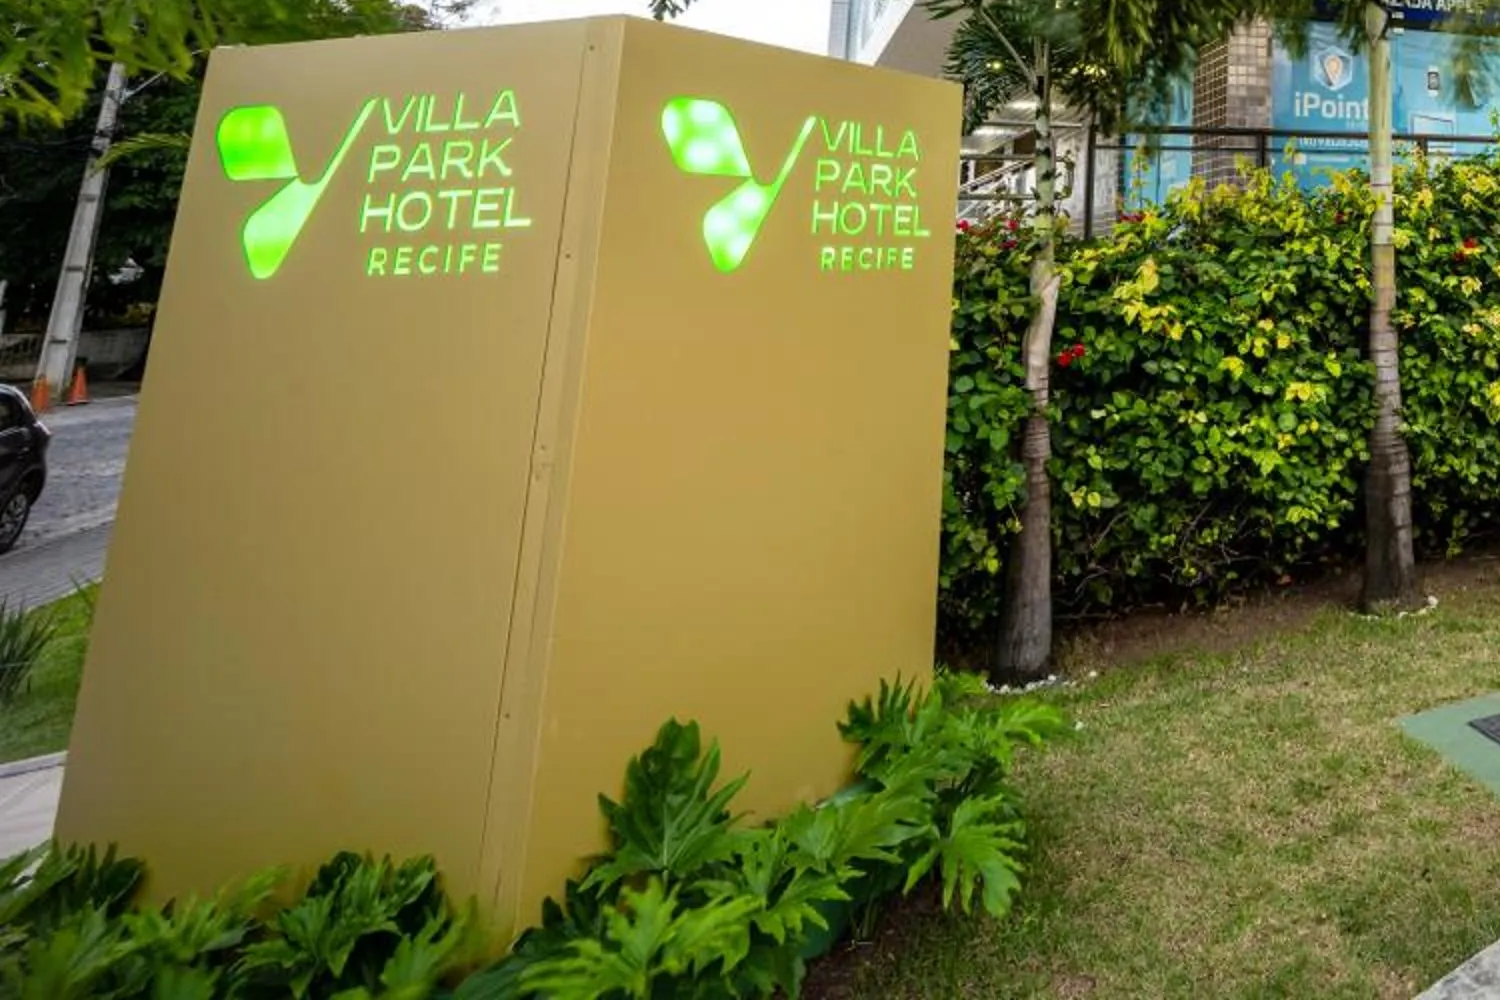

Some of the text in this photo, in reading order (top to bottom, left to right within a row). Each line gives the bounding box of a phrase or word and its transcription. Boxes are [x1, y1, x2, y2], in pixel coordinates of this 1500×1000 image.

[382, 90, 521, 134] VILLA
[819, 119, 919, 160] VILLA
[367, 137, 512, 183] PARK
[815, 160, 917, 197] PARK
[359, 187, 532, 232] HOTEL
[812, 200, 930, 237] HOTEL
[367, 243, 502, 276] RECIFE
[821, 246, 914, 270] RECIFE
